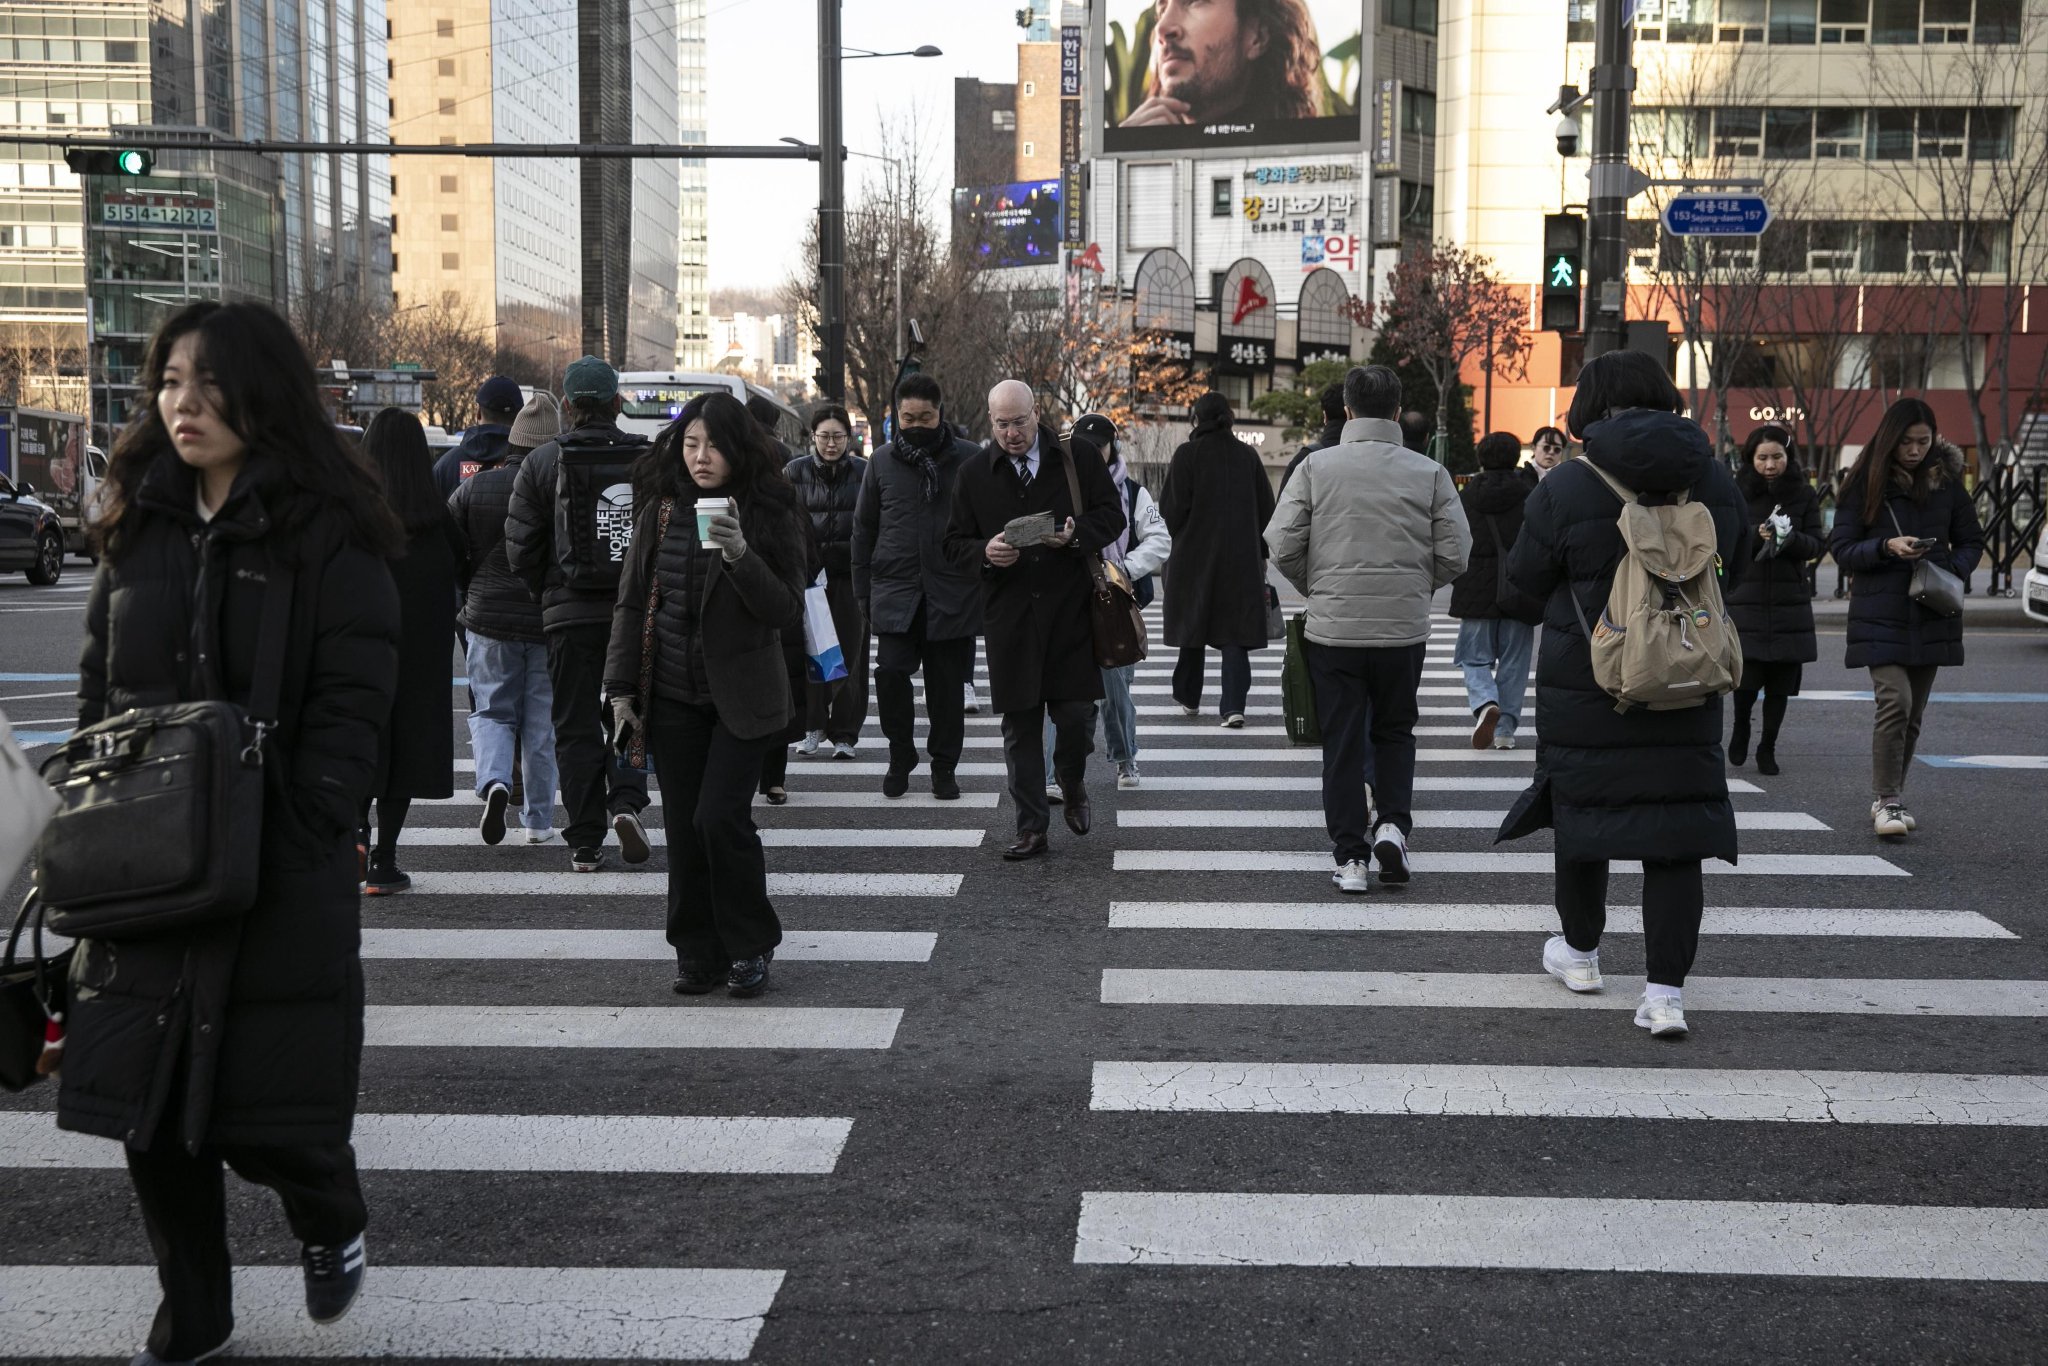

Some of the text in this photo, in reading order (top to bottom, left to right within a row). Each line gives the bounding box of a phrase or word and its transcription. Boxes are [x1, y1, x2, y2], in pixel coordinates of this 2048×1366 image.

[1063, 39, 1079, 93] 한의원
[107, 206, 212, 223] 554-1222
[1674, 210, 1762, 223] 153 Sejong-daero 157
[1694, 200, 1741, 213] 세종대로
[1292, 218, 1346, 233] 피부과
[1325, 234, 1359, 270] 약
[1238, 432, 1265, 446] SHOP
[597, 510, 609, 539] THE
[622, 510, 633, 547] FACE
[610, 511, 622, 562] NORTH
